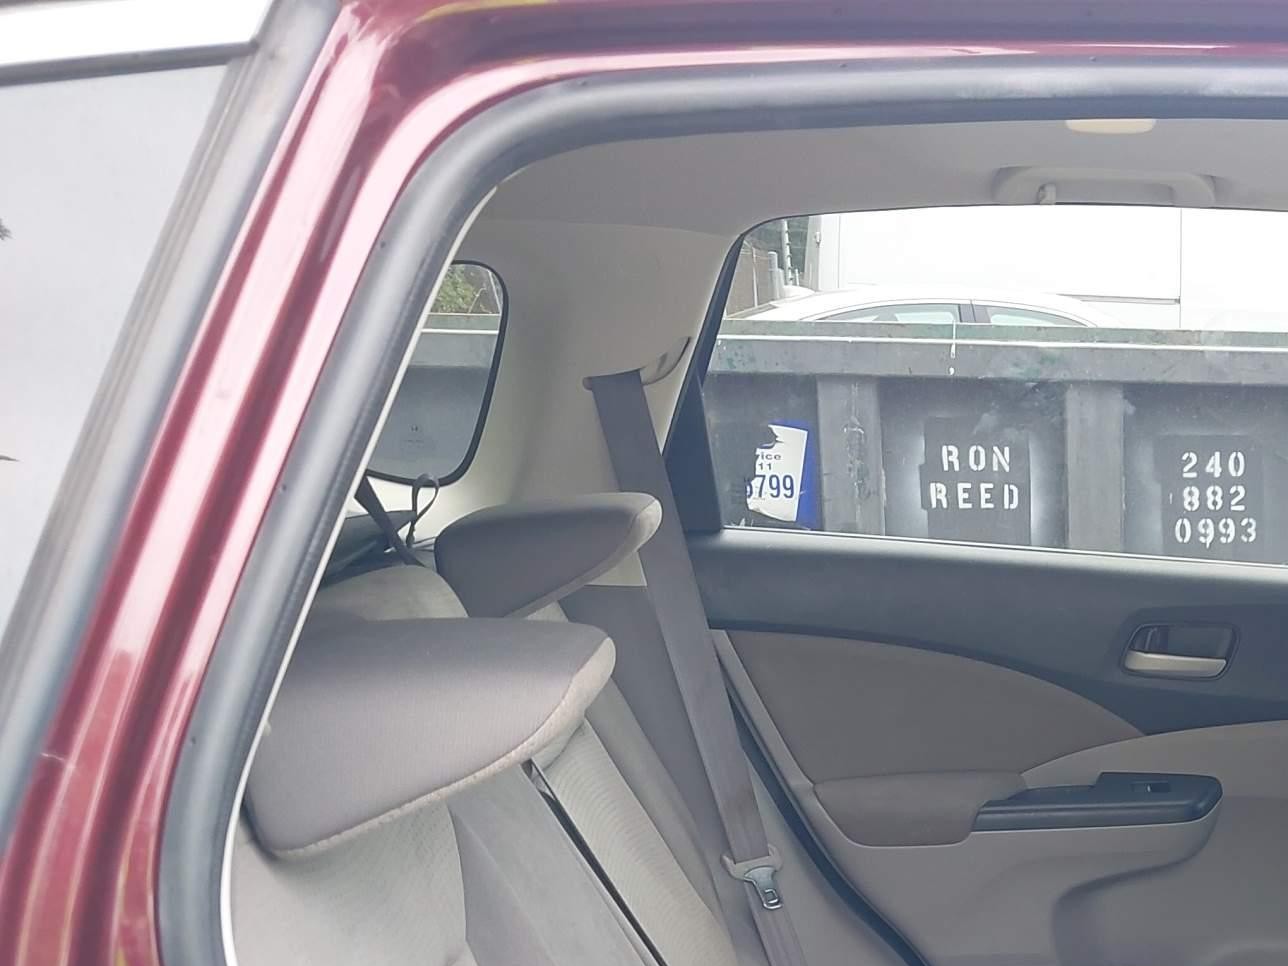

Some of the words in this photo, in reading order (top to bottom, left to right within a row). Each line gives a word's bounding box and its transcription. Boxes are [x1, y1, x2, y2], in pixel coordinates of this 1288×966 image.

[941, 445, 1010, 472] RON
[1181, 451, 1245, 478] 240
[930, 482, 1019, 509] REED
[1183, 485, 1246, 512] 882
[1175, 518, 1257, 547] 0993
